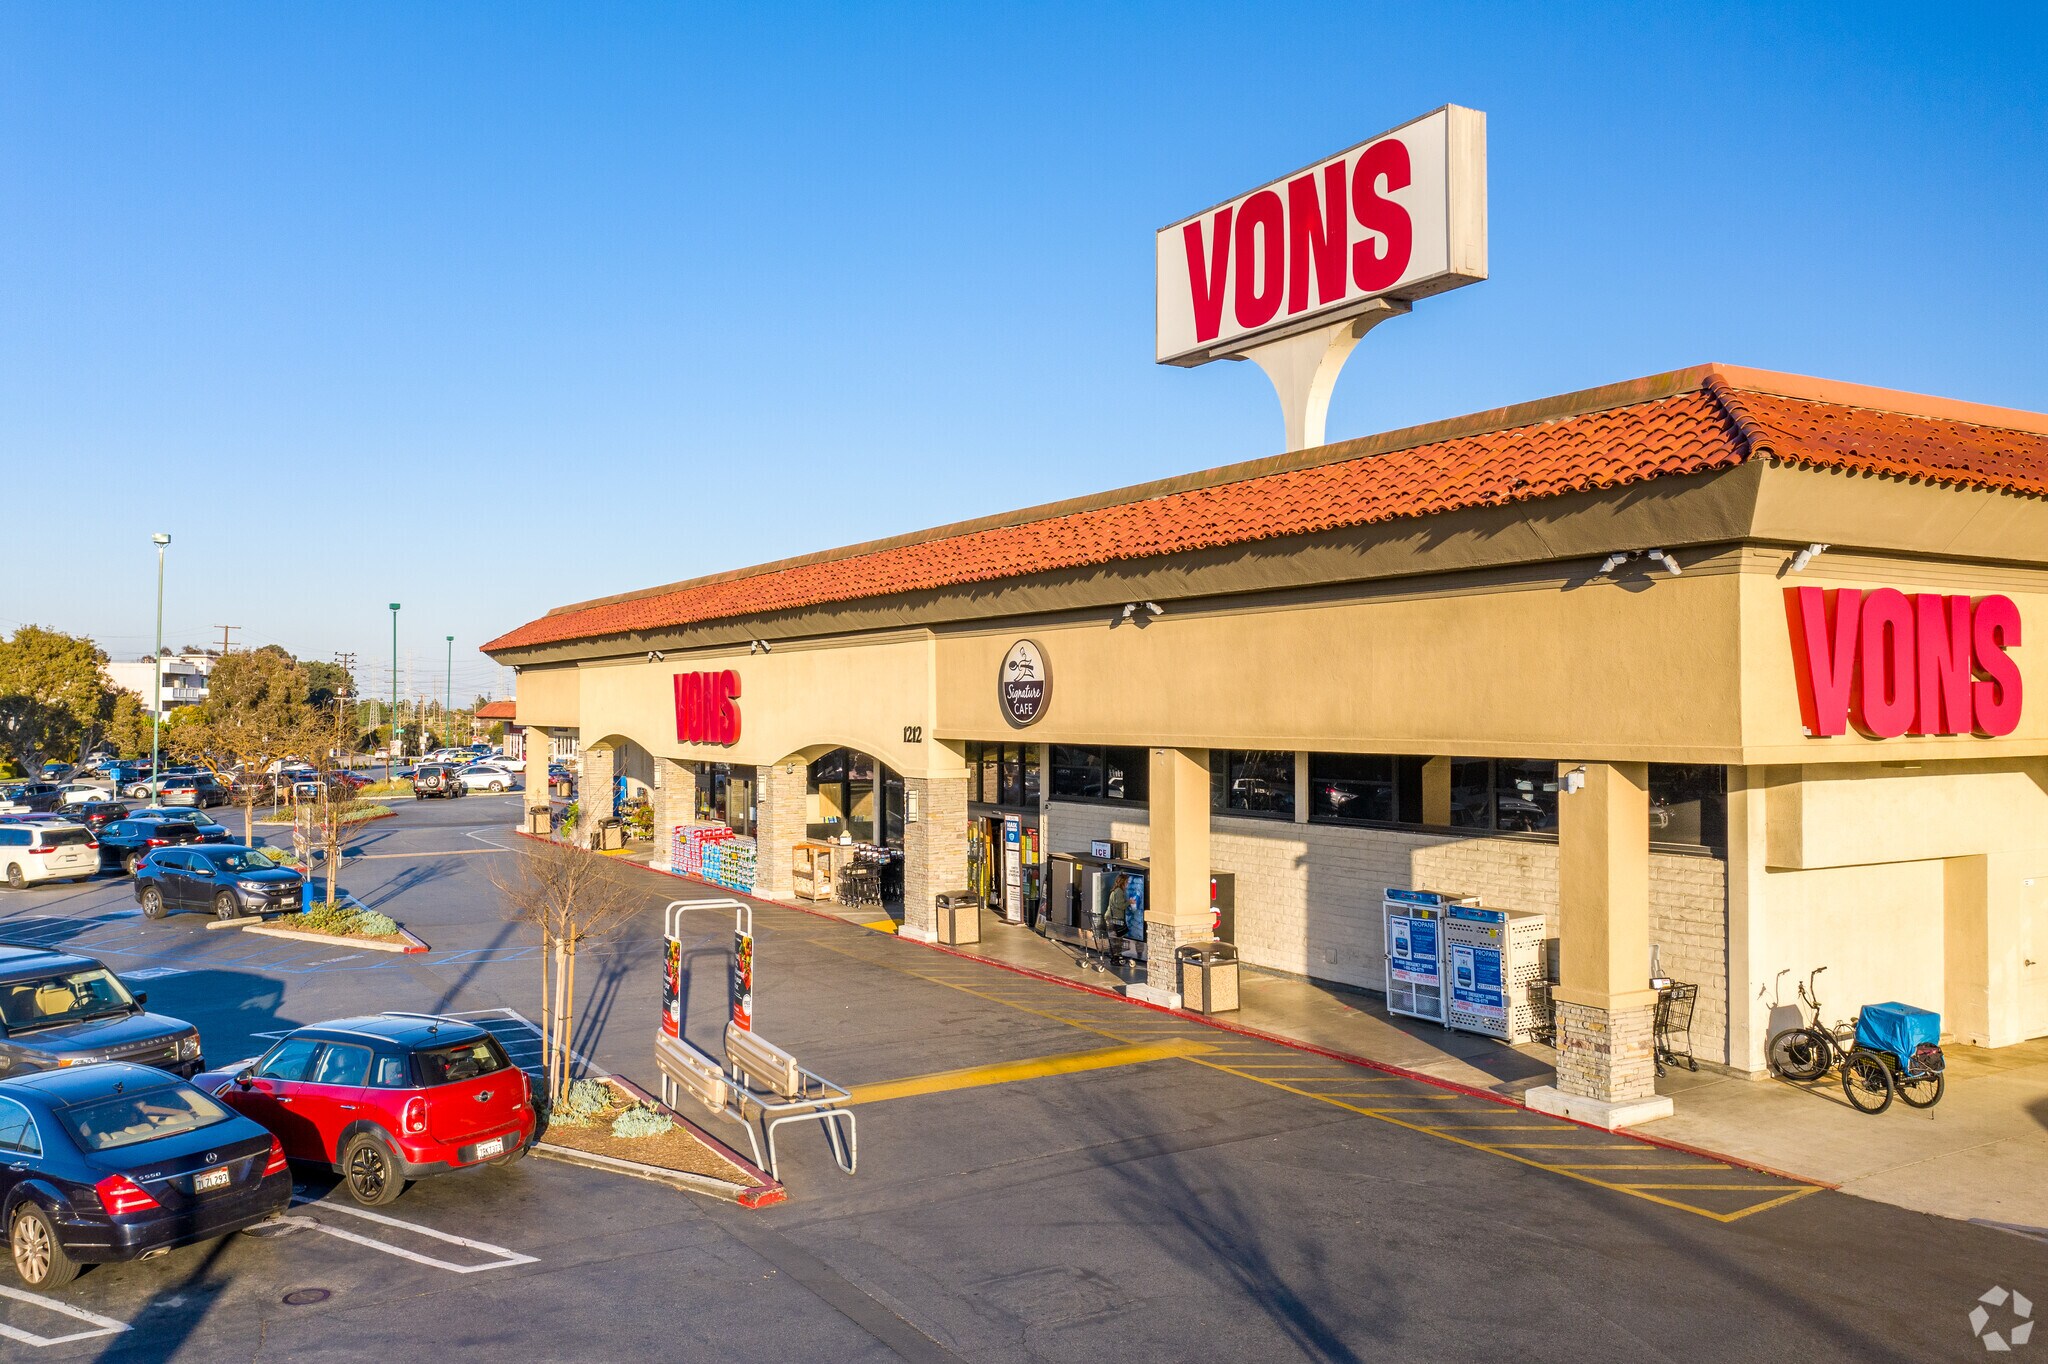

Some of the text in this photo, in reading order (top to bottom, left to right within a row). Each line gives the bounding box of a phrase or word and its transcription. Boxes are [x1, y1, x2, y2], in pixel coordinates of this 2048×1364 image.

[1182, 138, 1413, 344] VONS
[1782, 586, 2023, 739] VONS
[1007, 684, 1041, 703] Signature
[673, 669, 742, 745] VONS
[1014, 703, 1033, 715] CAFE
[903, 725, 922, 743] 1212
[1095, 849, 1107, 857] ICE
[1411, 921, 1435, 929] PROPANE
[1475, 949, 1500, 958] PROPANE
[105, 1036, 174, 1054] LAND ROVER
